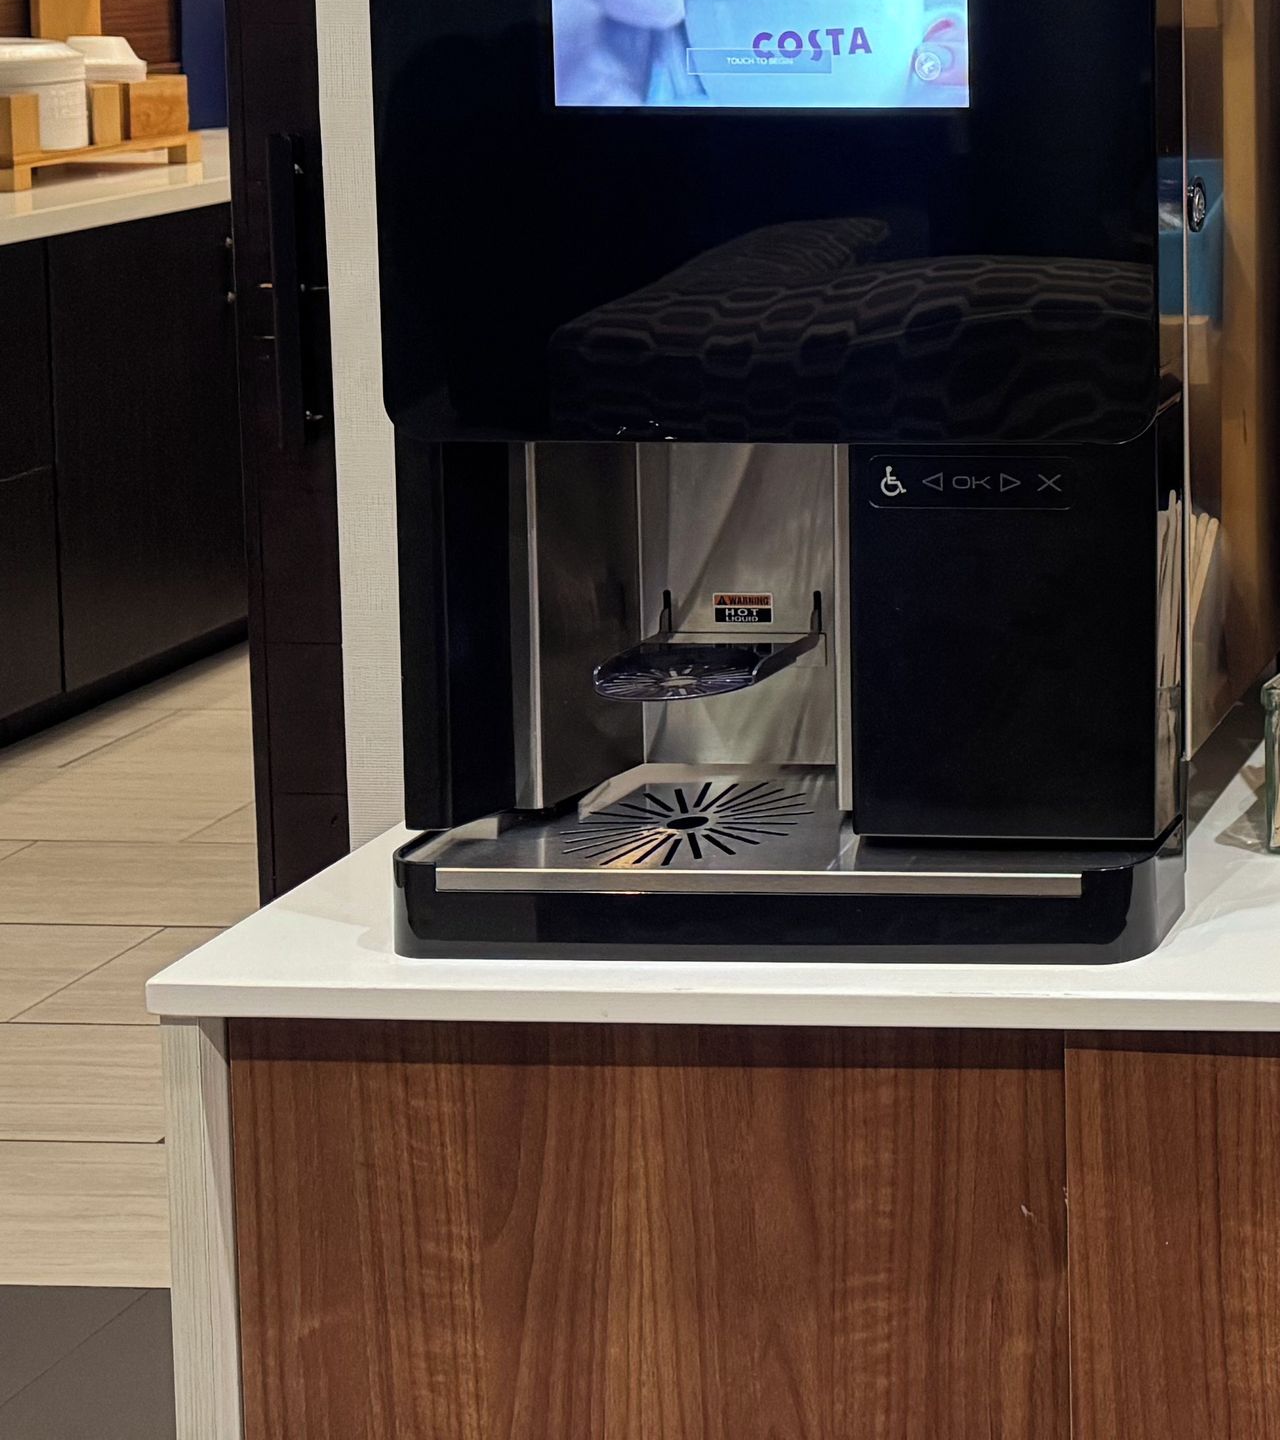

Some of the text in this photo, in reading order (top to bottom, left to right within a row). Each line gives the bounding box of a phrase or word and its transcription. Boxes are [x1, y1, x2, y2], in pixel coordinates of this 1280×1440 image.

[752, 26, 872, 62] COSTA
[952, 475, 991, 490] OK
[730, 596, 769, 605] WARNING
[725, 608, 759, 616] HOT
